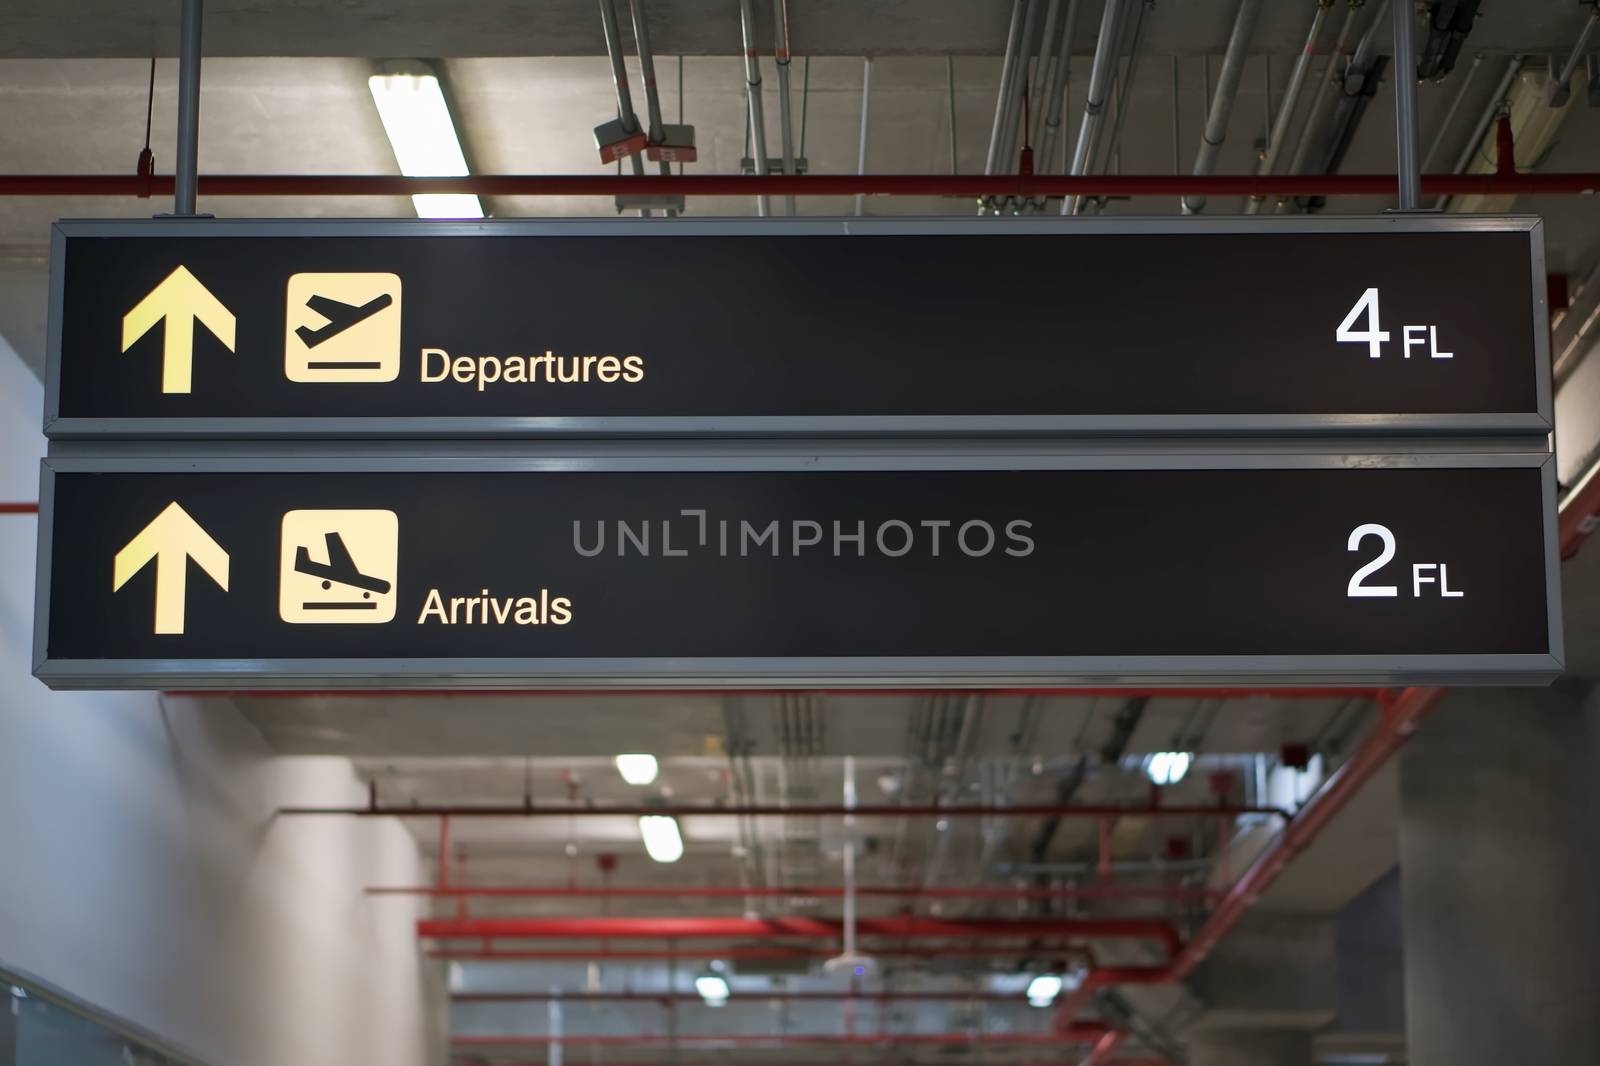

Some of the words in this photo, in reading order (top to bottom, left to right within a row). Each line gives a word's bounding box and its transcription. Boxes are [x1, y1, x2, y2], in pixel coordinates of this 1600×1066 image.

[1336, 288, 1390, 359] 4
[1403, 326, 1453, 359] FL
[421, 349, 644, 391] Departures
[1348, 524, 1398, 597] 2
[1413, 564, 1463, 597] FL
[418, 589, 572, 625] Arrivals
